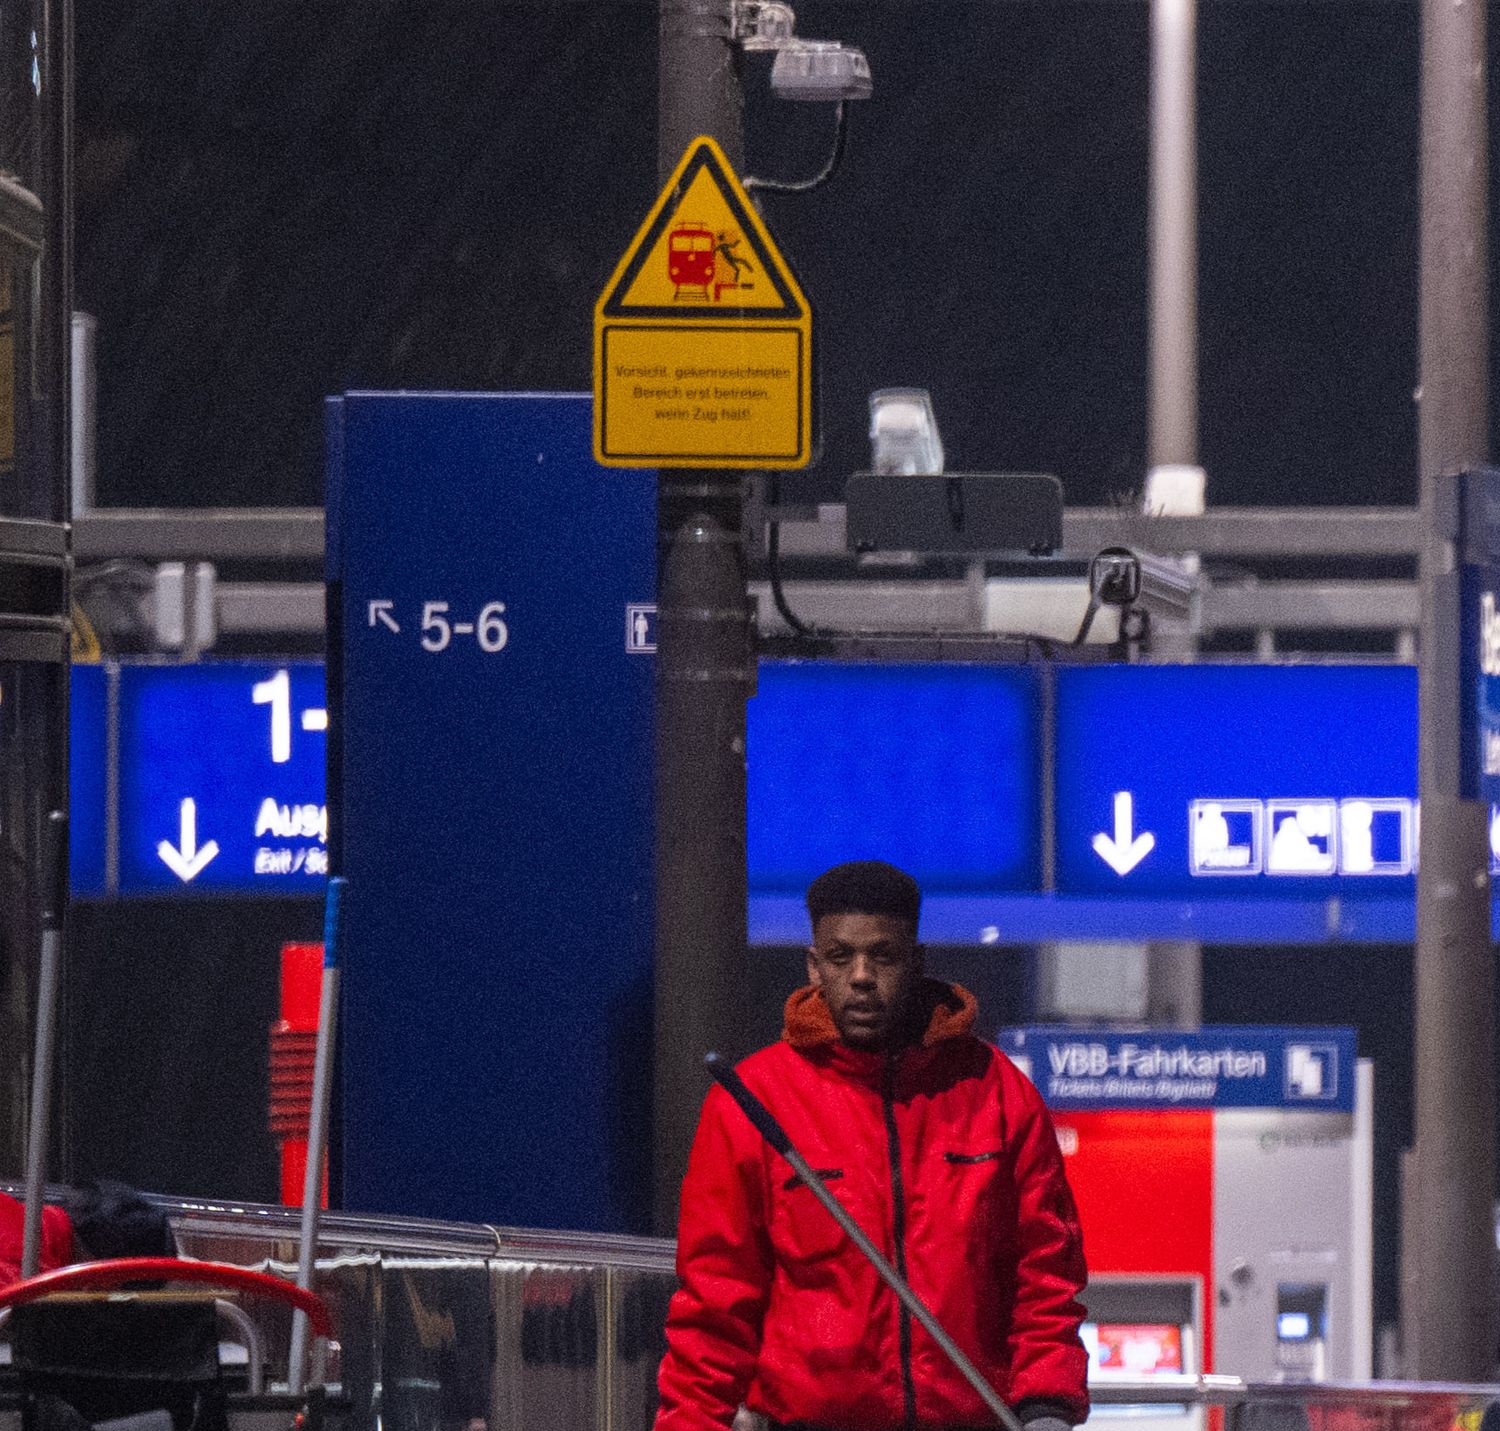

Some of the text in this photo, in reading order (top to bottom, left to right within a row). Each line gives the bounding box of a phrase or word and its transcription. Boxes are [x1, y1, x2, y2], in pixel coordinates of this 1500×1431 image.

[633, 386, 684, 400] Bereich
[686, 388, 710, 400] erst
[655, 410, 689, 421] wenn
[693, 408, 718, 423] Zug
[421, 600, 508, 653] 5-6
[1048, 1043, 1267, 1078] VBB-Fahrkarten
